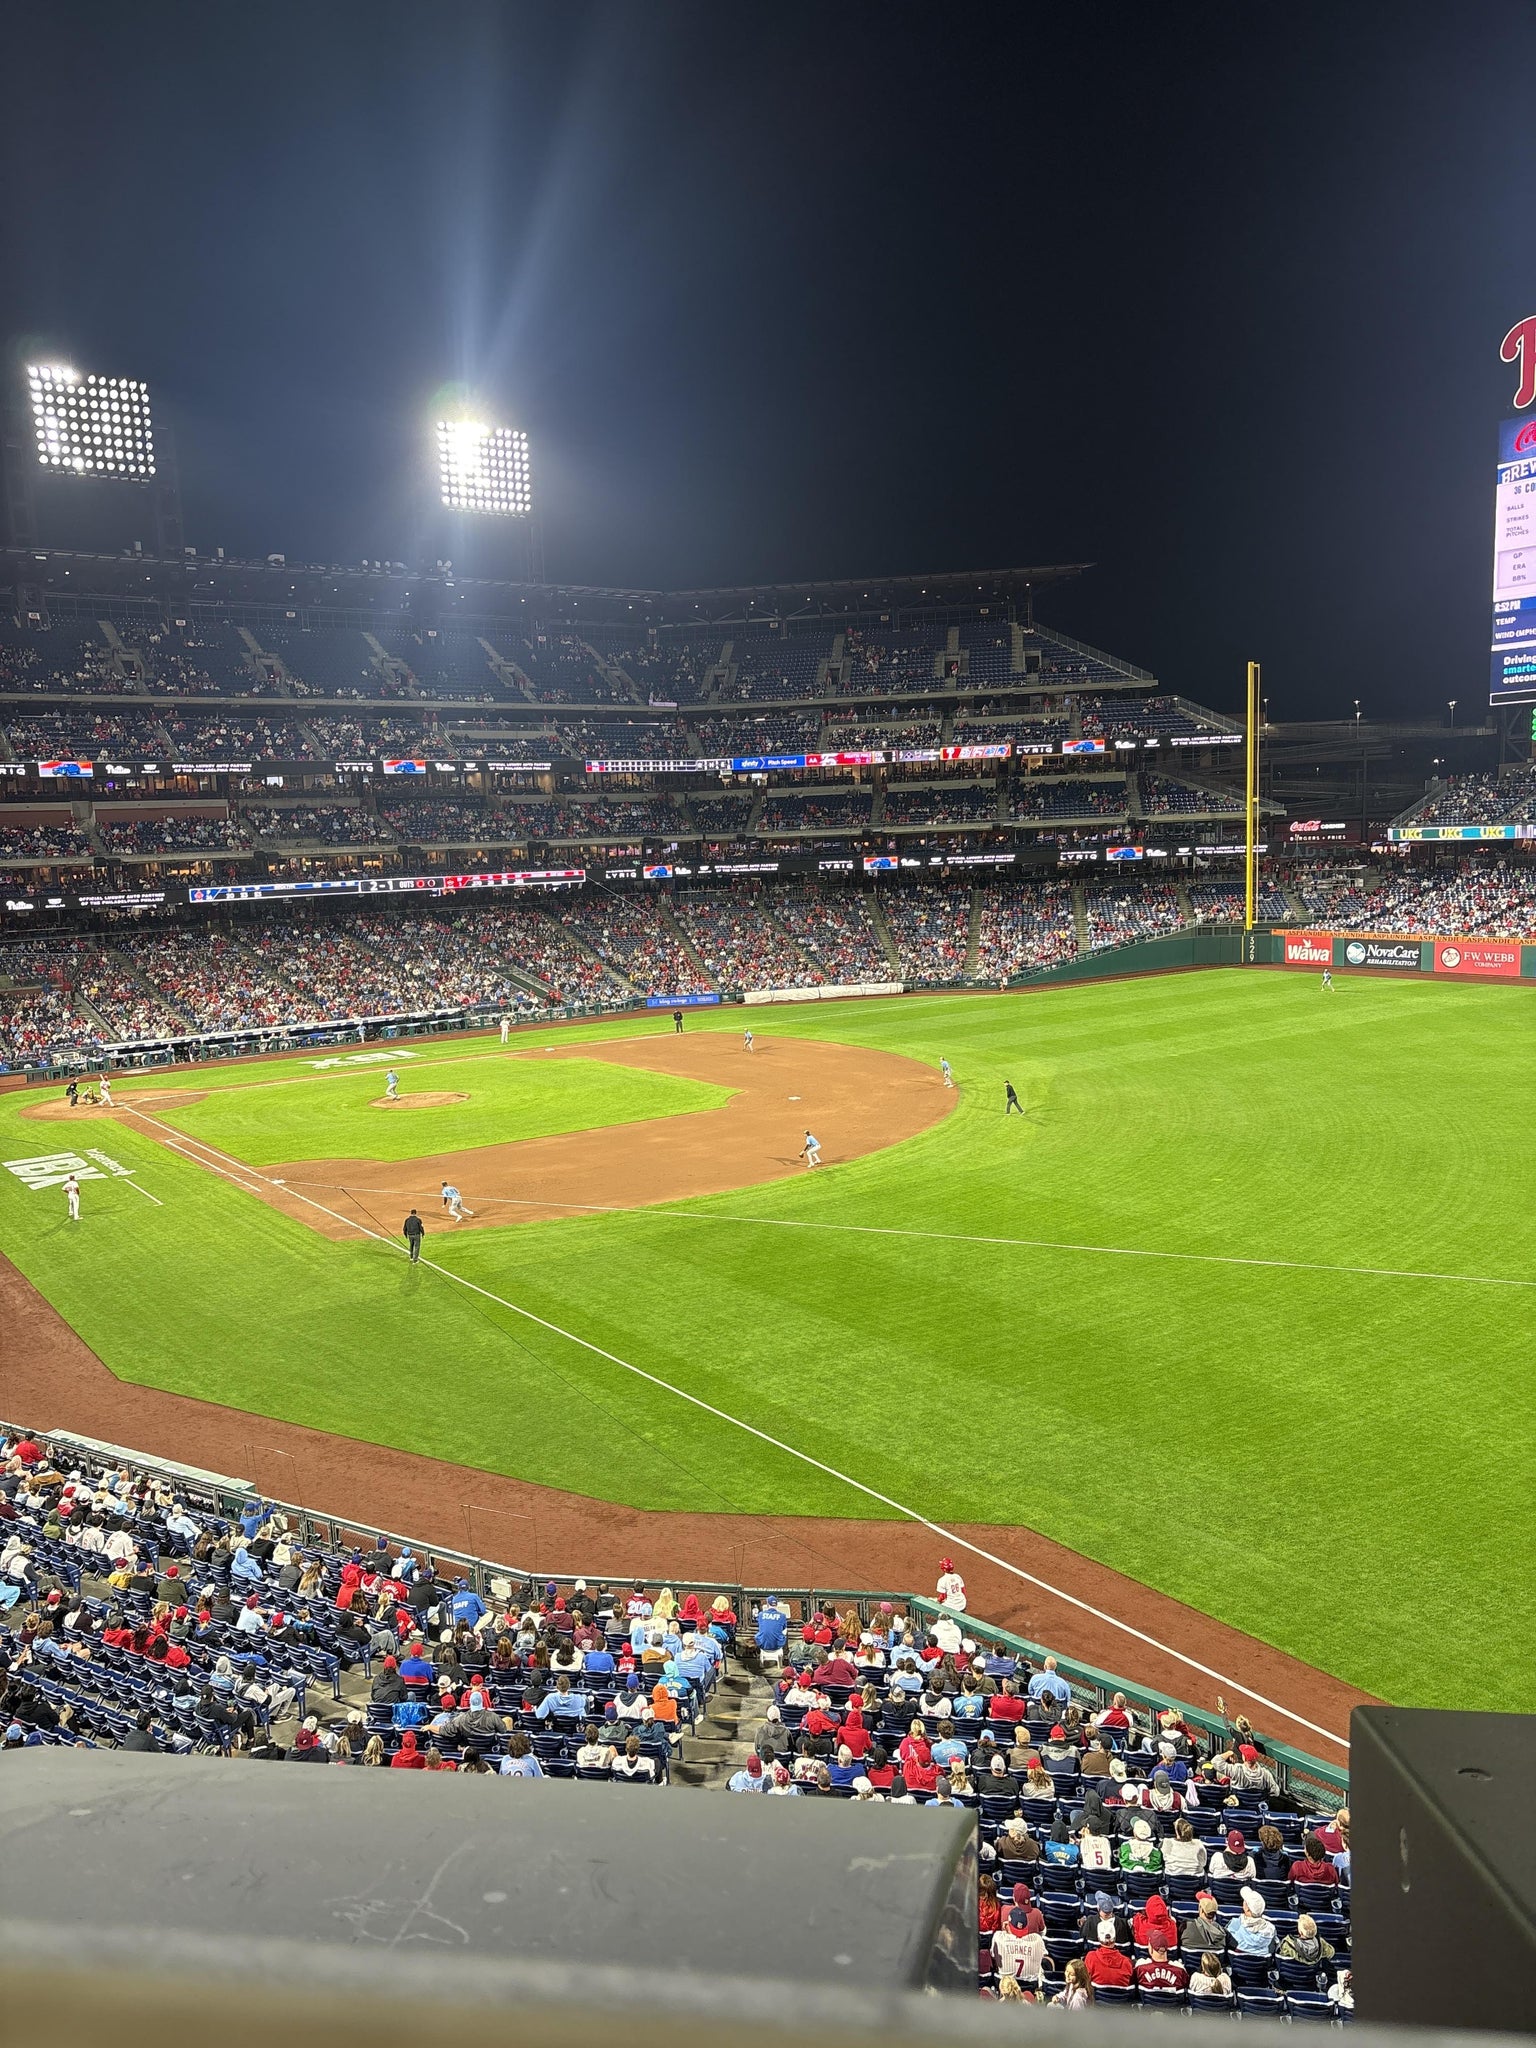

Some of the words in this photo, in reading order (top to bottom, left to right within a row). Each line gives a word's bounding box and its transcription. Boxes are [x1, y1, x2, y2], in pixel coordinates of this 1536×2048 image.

[1507, 504, 1524, 512] BALLS
[1506, 514, 1529, 523] STRIKES
[1506, 529, 1529, 538] PITCHES
[1510, 600, 1521, 610] PM
[1496, 617, 1516, 626] TEMP
[1495, 631, 1514, 640] WIND
[1290, 820, 1321, 832] Coca-Cola
[1400, 829, 1422, 839] UKG
[1439, 828, 1463, 838] UKG
[1480, 827, 1505, 838] UKG
[400, 880, 414, 888] OUTS
[1288, 945, 1330, 961] Wawa
[1367, 944, 1419, 959] NovaCare
[1464, 952, 1480, 961] F.W.
[1484, 952, 1515, 962] WEBB
[1, 1152, 108, 1190] IBX
[454, 1600, 468, 1610] STAFF
[1095, 1851, 1103, 1865] 5
[1006, 1945, 1032, 1956] TURNER
[1015, 1959, 1024, 1977] 7
